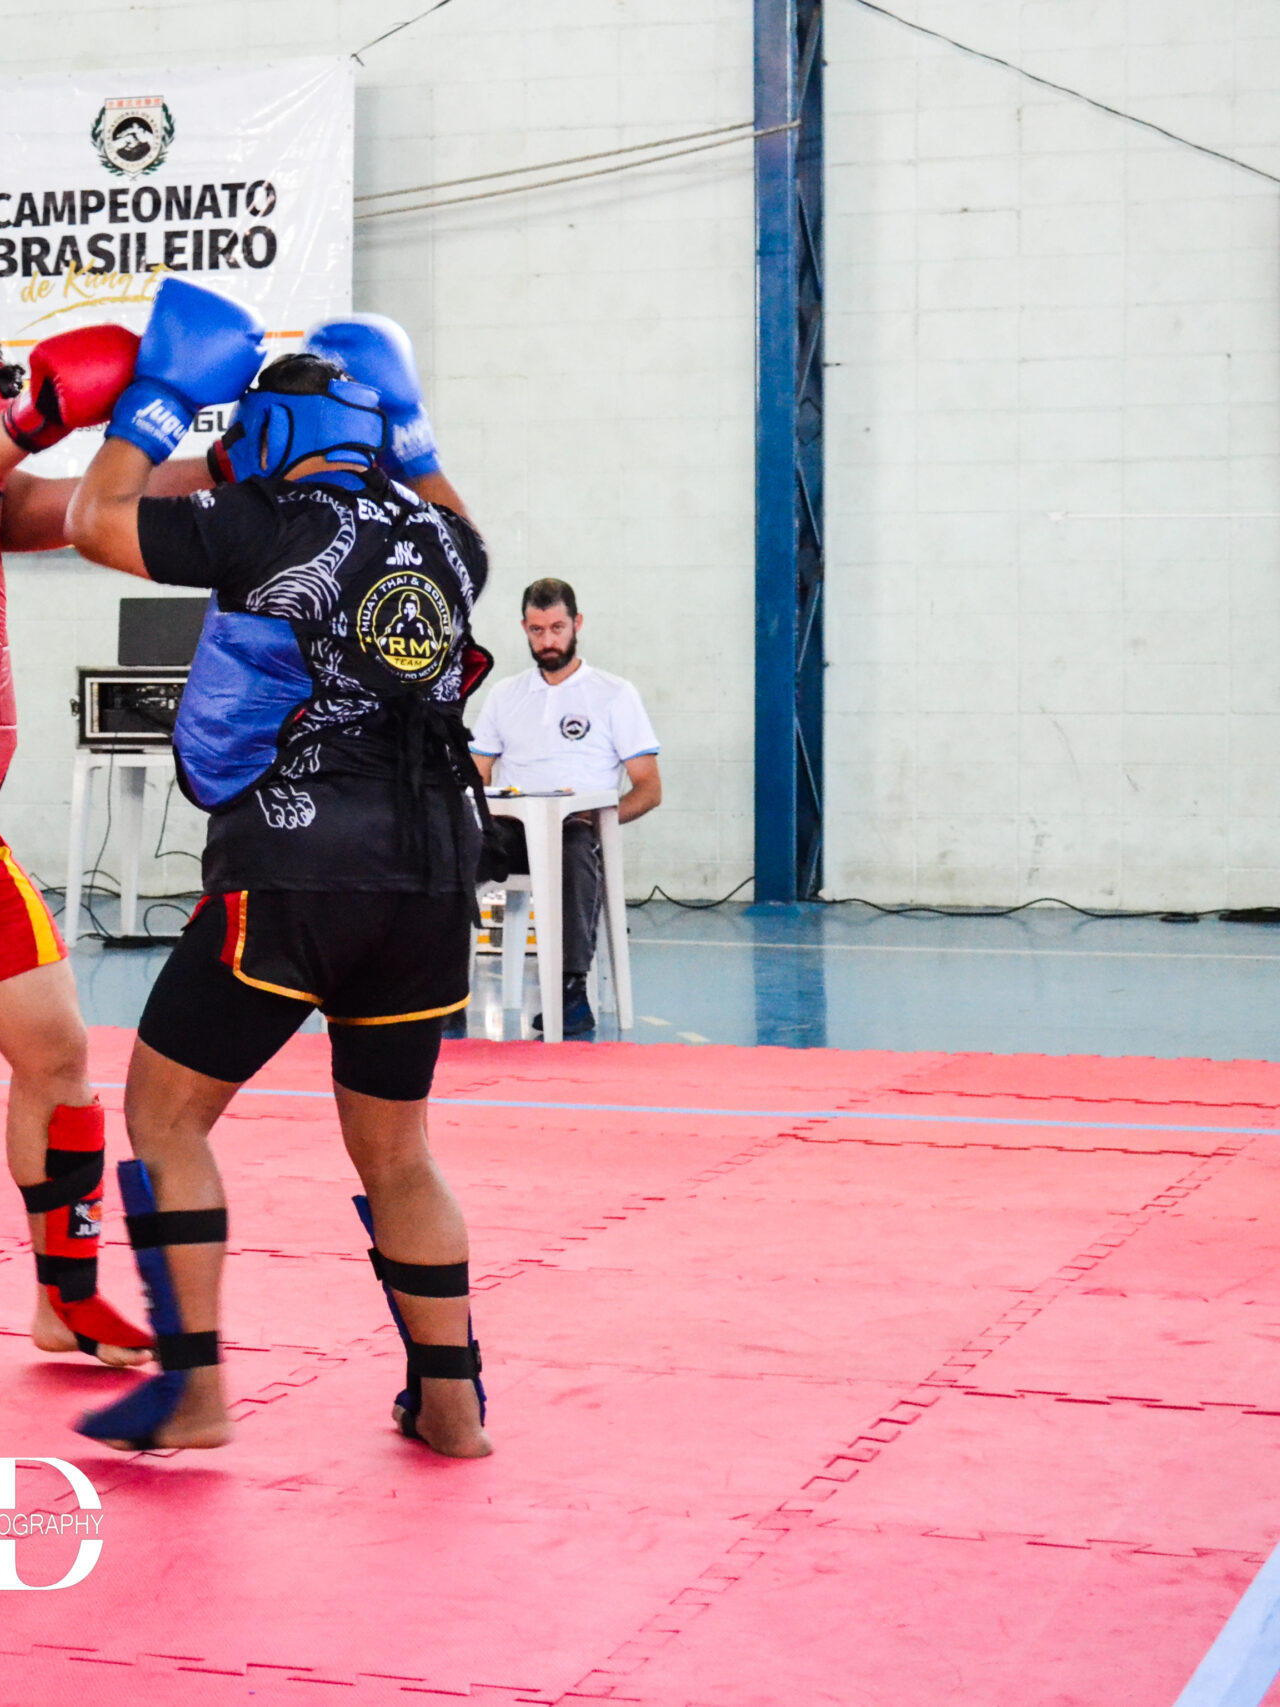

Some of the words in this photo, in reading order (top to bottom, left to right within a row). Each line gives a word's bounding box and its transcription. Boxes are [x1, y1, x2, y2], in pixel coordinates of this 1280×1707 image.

[21, 271, 54, 303] de
[361, 593, 378, 632] MUAY
[379, 576, 407, 593] THAI
[388, 636, 430, 657] RM
[394, 658, 423, 666] TEAM
